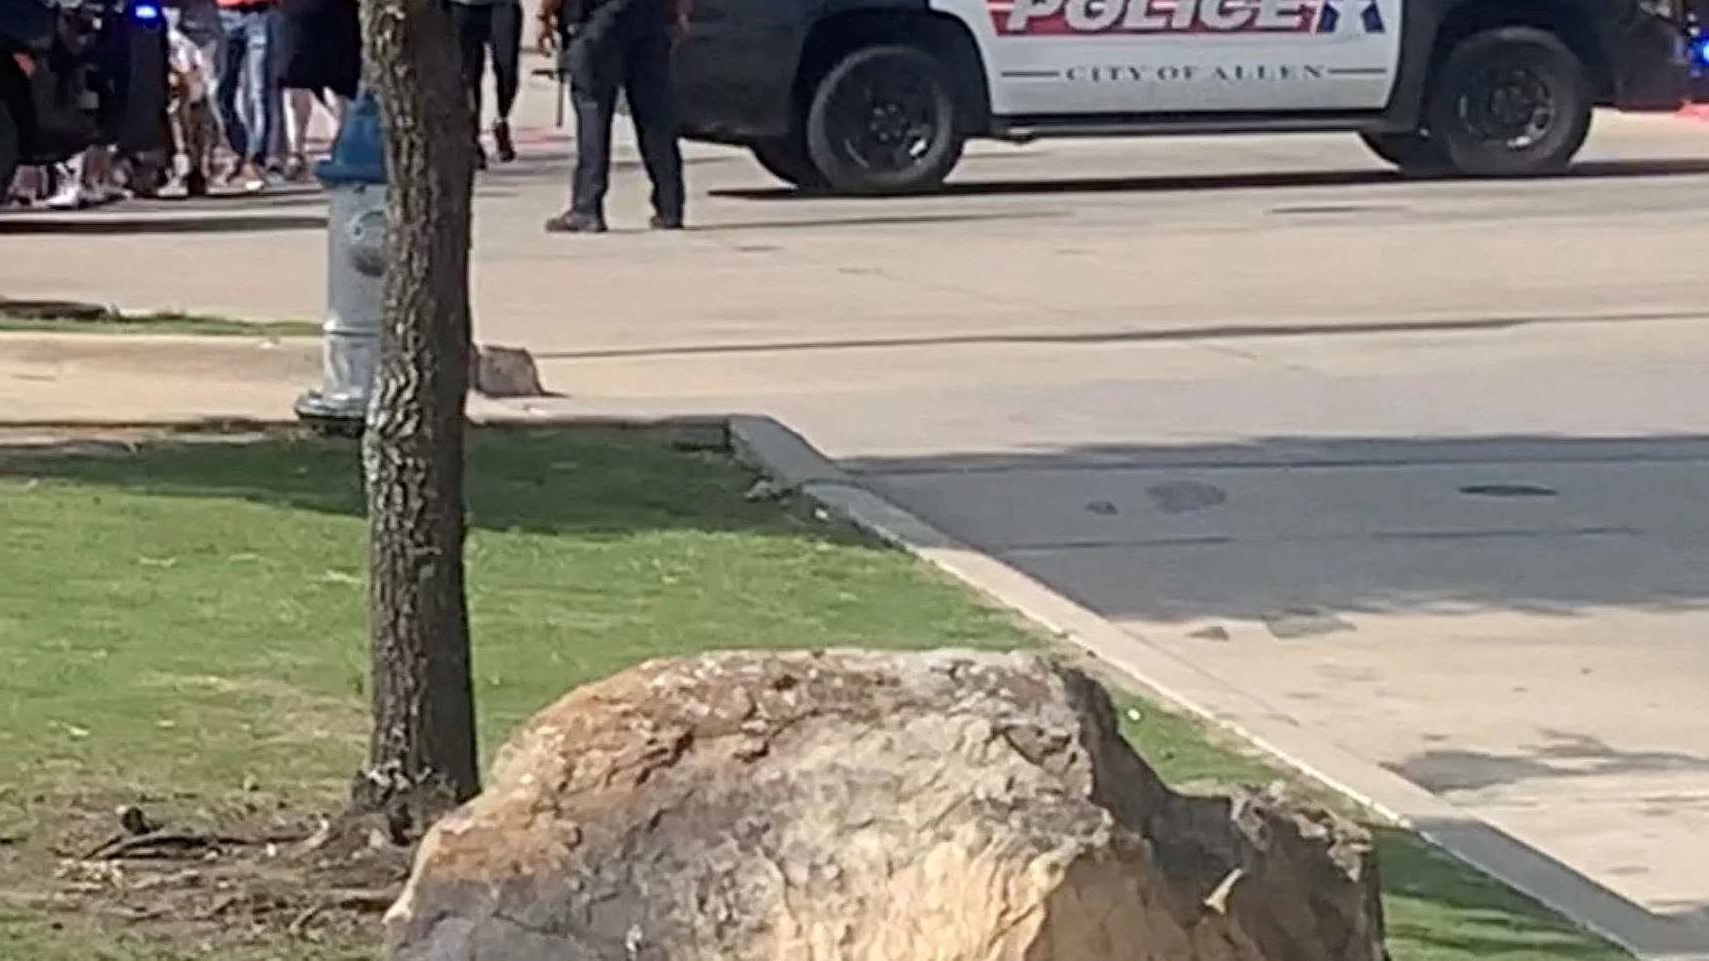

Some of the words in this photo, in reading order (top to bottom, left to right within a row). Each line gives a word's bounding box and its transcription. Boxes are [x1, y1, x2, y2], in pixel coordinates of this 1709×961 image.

[1066, 65, 1149, 82] CITY
[1154, 65, 1191, 82] OF
[1213, 63, 1326, 82] ALLEN
